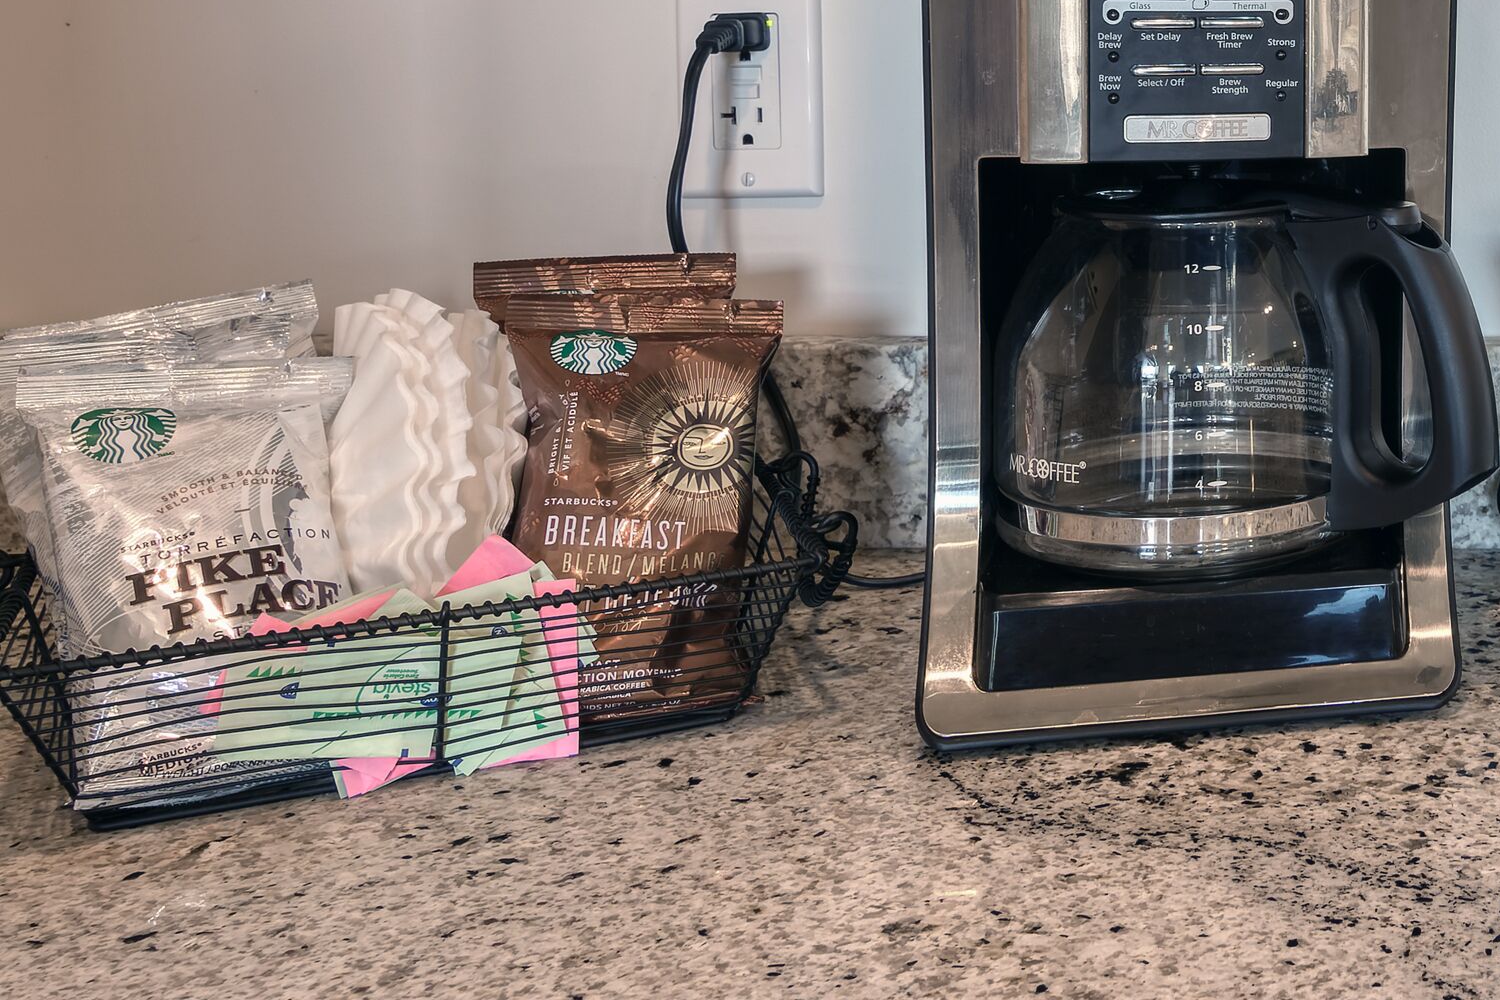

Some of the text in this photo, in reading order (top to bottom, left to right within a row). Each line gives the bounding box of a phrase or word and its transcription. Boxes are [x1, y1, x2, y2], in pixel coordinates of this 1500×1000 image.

[1129, 1, 1151, 11] Glass
[1232, 1, 1267, 10] Thermal
[1097, 32, 1123, 43] Delay
[1140, 32, 1181, 43] Set Delay
[1206, 32, 1253, 41] Fresh Brew
[1098, 40, 1121, 49] Brew
[1217, 40, 1242, 49] Timer
[1267, 38, 1296, 48] Strong
[1098, 74, 1121, 83] Brew
[1137, 79, 1185, 87] Select / Off
[1218, 78, 1242, 87] Brew
[1265, 79, 1298, 89] Regular
[1099, 82, 1121, 91] Now
[1211, 86, 1249, 95] Strength
[1183, 263, 1199, 275] 12
[1186, 323, 1203, 336] 10
[1193, 380, 1203, 393] 8
[562, 391, 578, 471] VIF ET ACIDULÉ
[1194, 430, 1203, 442] 6
[547, 437, 560, 475] BRIGHT
[160, 475, 215, 503] SMOOTH
[236, 466, 303, 481] BALANCED
[1194, 478, 1204, 490] 4
[156, 485, 215, 514] VELOUTÉ
[220, 481, 236, 490] ET
[544, 515, 686, 550] BREAKFAST
[140, 527, 331, 564] TORRÉFACTION
[125, 543, 287, 606] PIKE
[373, 680, 432, 700] stevia
[613, 681, 646, 691] COFFEE
